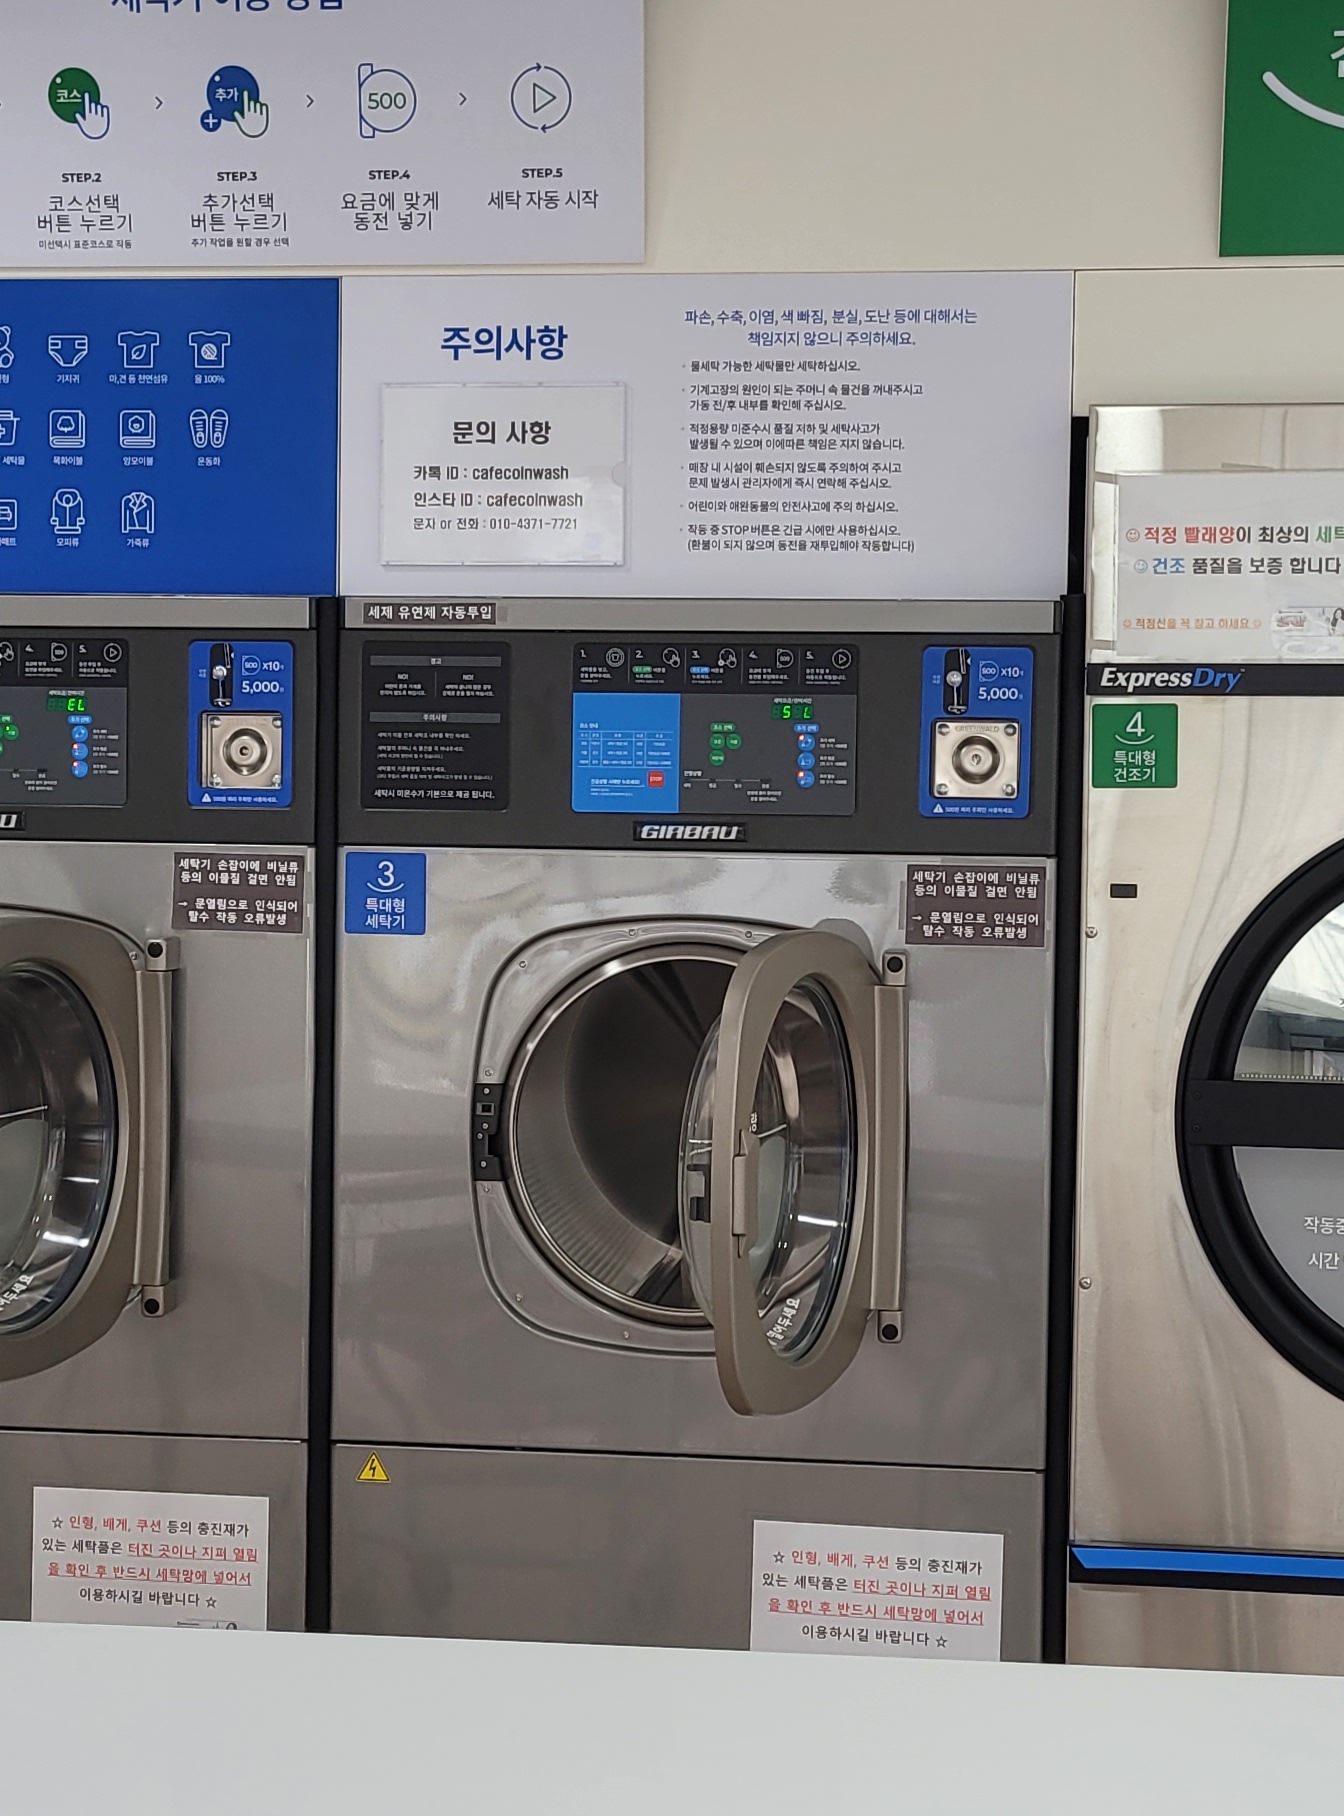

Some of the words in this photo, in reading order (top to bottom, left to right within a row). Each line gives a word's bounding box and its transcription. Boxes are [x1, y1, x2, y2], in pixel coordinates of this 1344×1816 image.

[56, 89, 82, 102] 코스
[215, 87, 238, 102] 추가
[367, 92, 406, 110] 500
[61, 172, 102, 183] STEP.2
[217, 171, 257, 181] STEP.3
[368, 169, 410, 180] STEP.4
[521, 168, 563, 178] STEP.5
[48, 193, 119, 213] 코스선택
[202, 192, 273, 213] 추가선택
[341, 191, 394, 213] 요금에
[404, 191, 438, 213] 맞게
[487, 190, 522, 210] 세탁
[526, 189, 560, 210] 자동
[564, 189, 599, 209] 시작
[37, 214, 72, 233] 버튼
[79, 212, 132, 233] 누르기
[190, 211, 226, 232] 버튼
[233, 210, 286, 232] 누르기
[353, 211, 388, 231] 동전
[398, 211, 431, 230] 넣기
[684, 309, 714, 326] 파손,
[716, 309, 746, 326] 수축,
[749, 309, 778, 326] 이염,
[780, 309, 794, 324] 색
[795, 309, 827, 326] 빠짐,
[832, 309, 862, 326] 분실,
[864, 308, 890, 324] 도난
[893, 308, 921, 324] 등에
[922, 308, 977, 324] 대해서는
[441, 325, 568, 361] 주의사항
[748, 331, 800, 347] 책임지지
[803, 331, 842, 346] 않으니
[846, 330, 916, 346] 주의하세요.
[452, 421, 495, 444] 문의
[505, 420, 551, 445] 사항
[414, 465, 441, 480] 카톡
[446, 466, 458, 480] ID
[414, 492, 456, 507] 인스타
[460, 493, 473, 507] ID
[413, 517, 435, 530] 문자
[440, 519, 452, 529] or
[456, 517, 479, 530] 전화
[489, 517, 576, 530] 010-4371-7721
[1144, 526, 1176, 544] 적정
[1184, 526, 1253, 544] 빨래양이
[1258, 525, 1310, 544] 최상의
[1153, 558, 1184, 574] 건조
[1191, 557, 1242, 576] 품질을
[1248, 557, 1282, 575] 보증
[1288, 557, 1341, 576] 합니다
[1126, 711, 1145, 736] 4
[1112, 750, 1158, 767] 특대형
[1114, 767, 1155, 782] 건조기
[377, 861, 394, 886] 3
[365, 897, 405, 915] 특대형
[365, 911, 404, 929] 세탁기
[791, 1550, 820, 1566] 인형,
[862, 1554, 889, 1569] 쿠션
[895, 1555, 921, 1572] 등의
[927, 1558, 982, 1576] 충진재가
